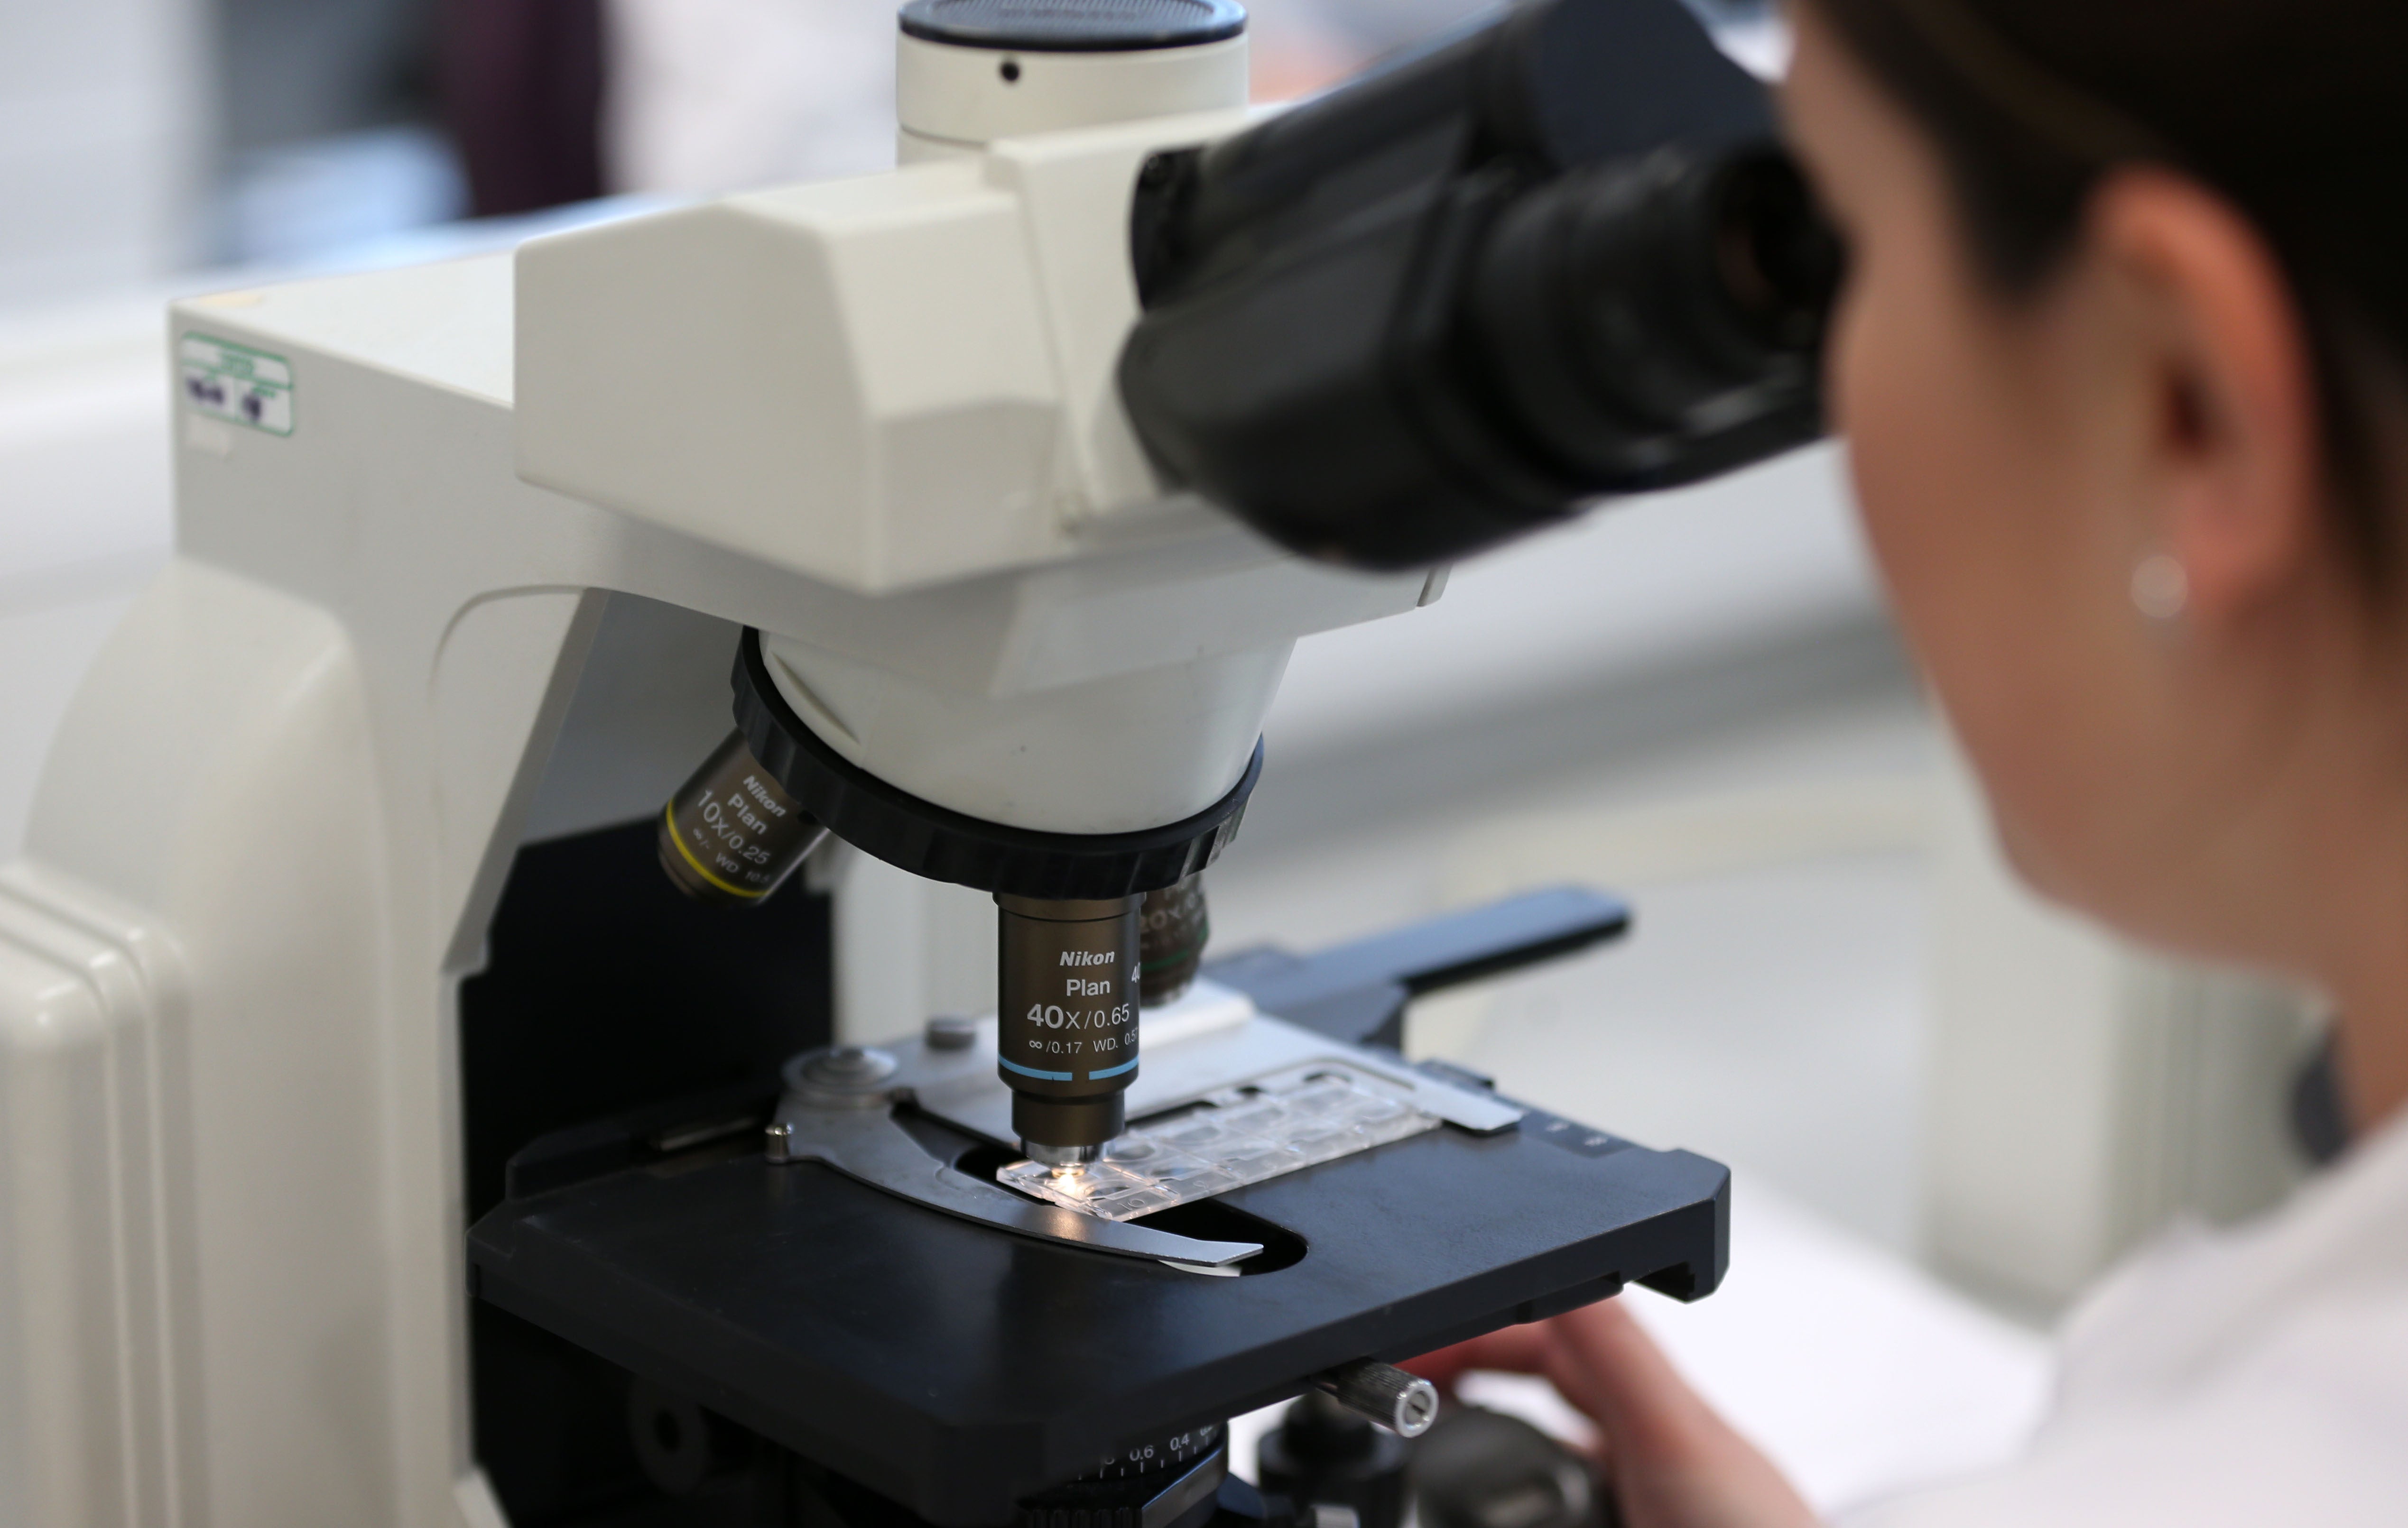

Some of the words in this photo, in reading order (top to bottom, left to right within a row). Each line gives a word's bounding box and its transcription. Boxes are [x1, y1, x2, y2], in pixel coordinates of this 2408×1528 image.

[743, 775, 786, 817] Nikon
[728, 793, 767, 835] Plan
[1059, 951, 1115, 966] Nikon
[1066, 979, 1111, 996] Plan
[1093, 1038, 1118, 1052] WD.
[1170, 1433, 1190, 1451] 0.4
[1129, 1445, 1154, 1462] 0.6
